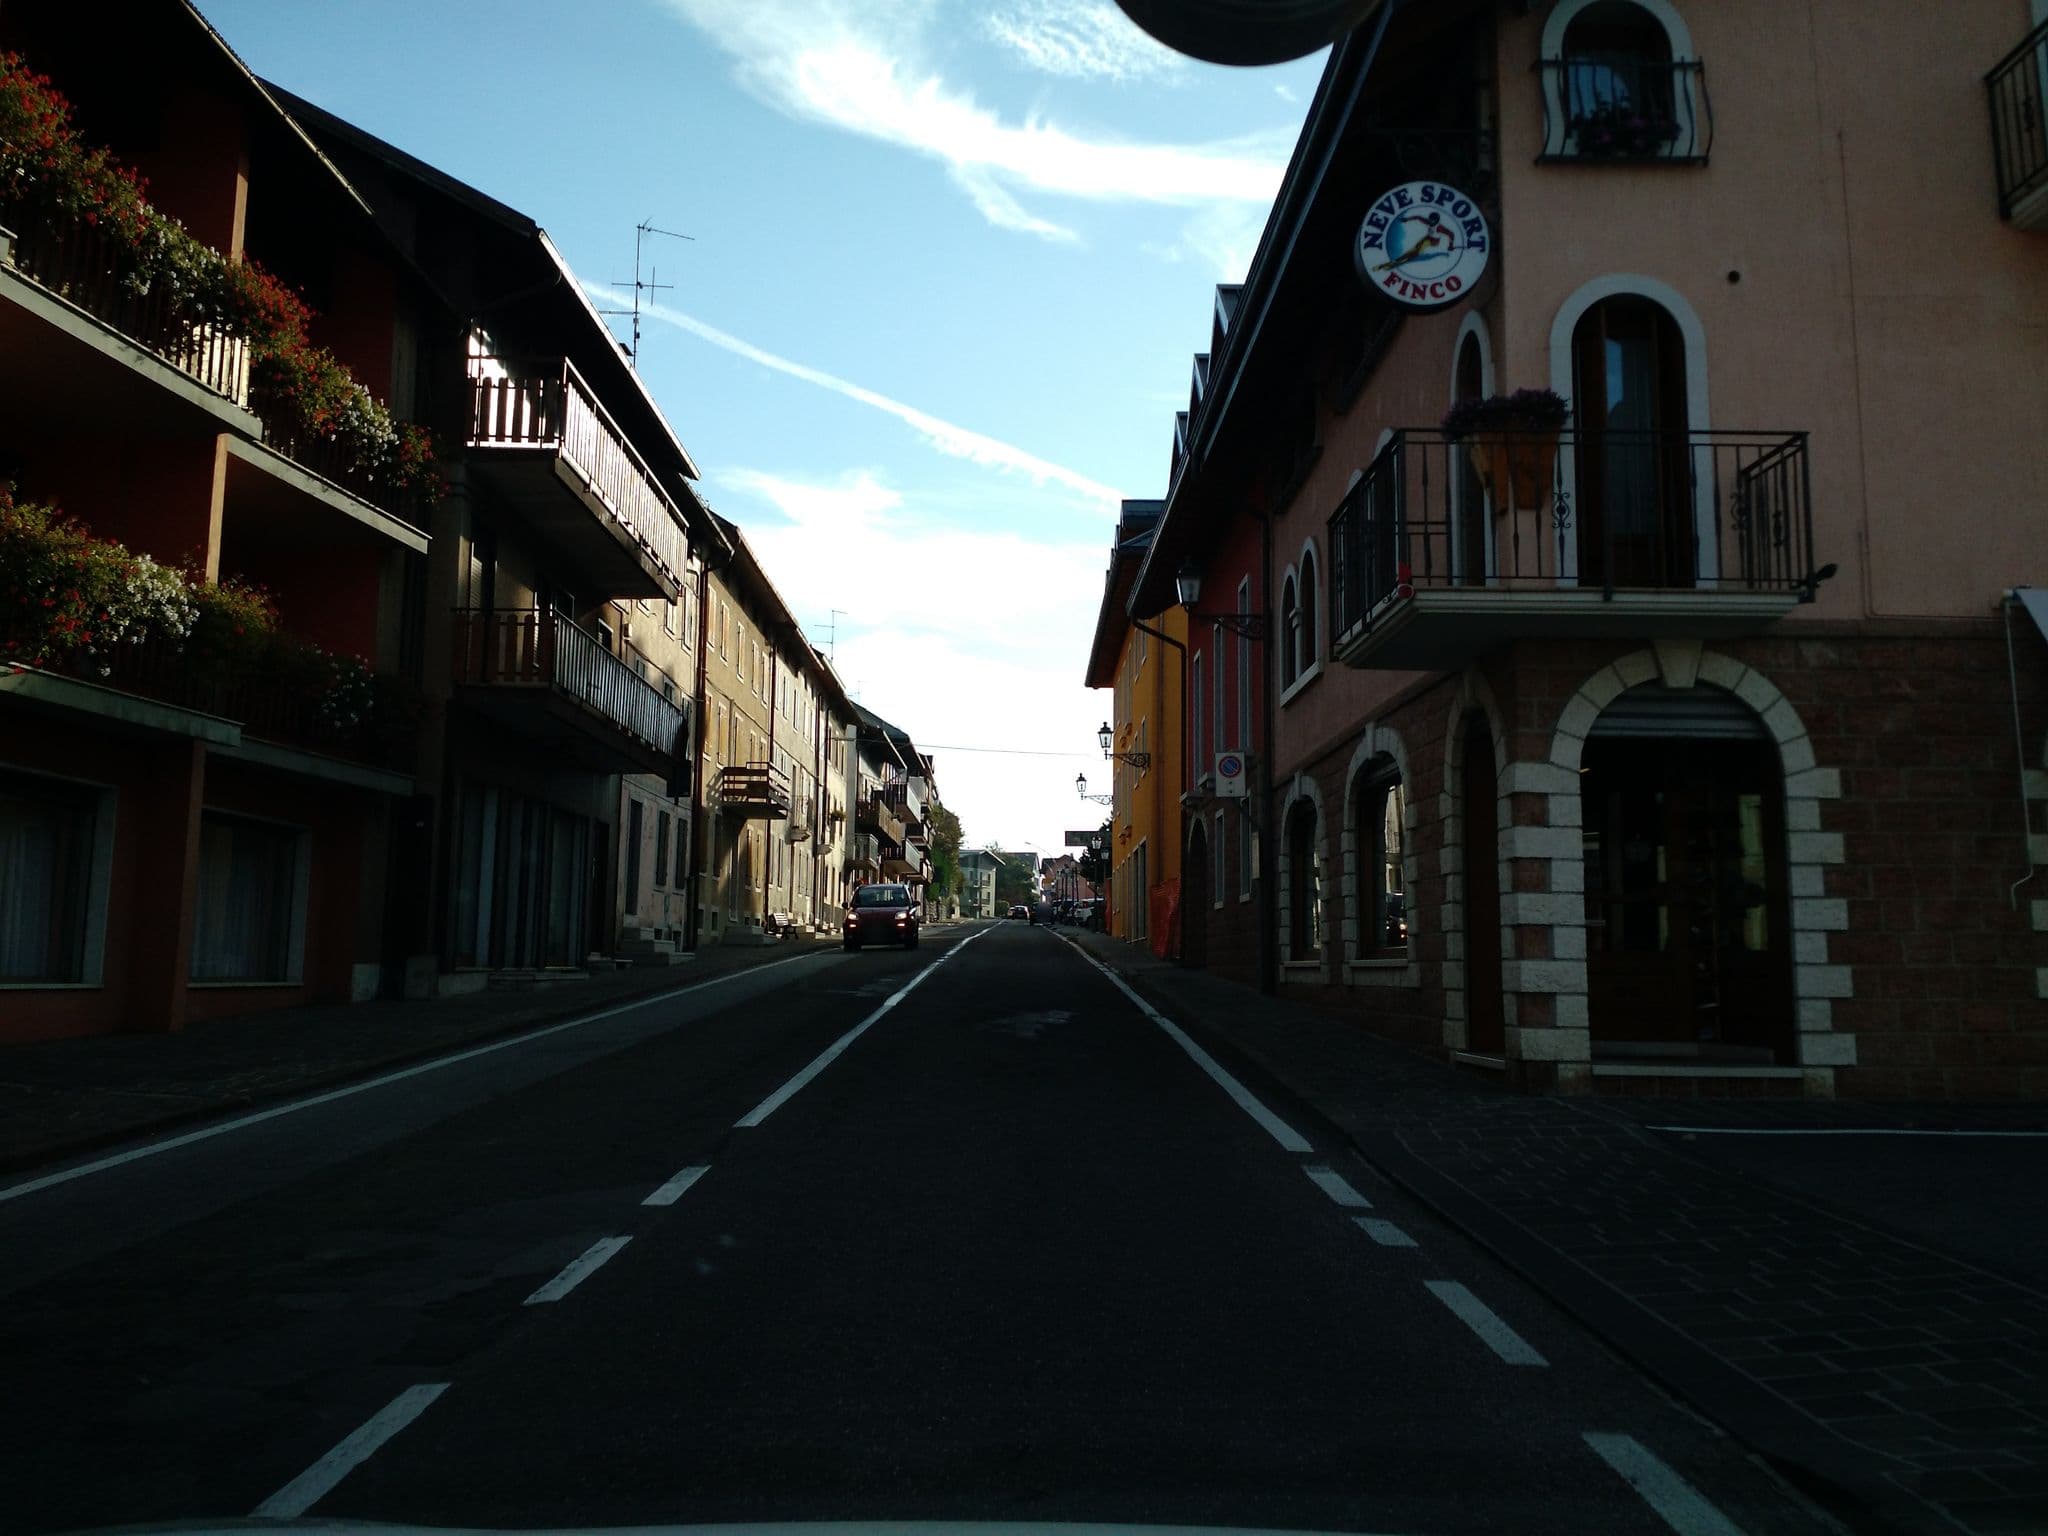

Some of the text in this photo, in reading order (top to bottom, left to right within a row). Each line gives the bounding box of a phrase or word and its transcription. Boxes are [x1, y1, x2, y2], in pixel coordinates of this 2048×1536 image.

[1364, 185, 1486, 252] NEVE SPORT
[1383, 272, 1462, 300] FINCO
